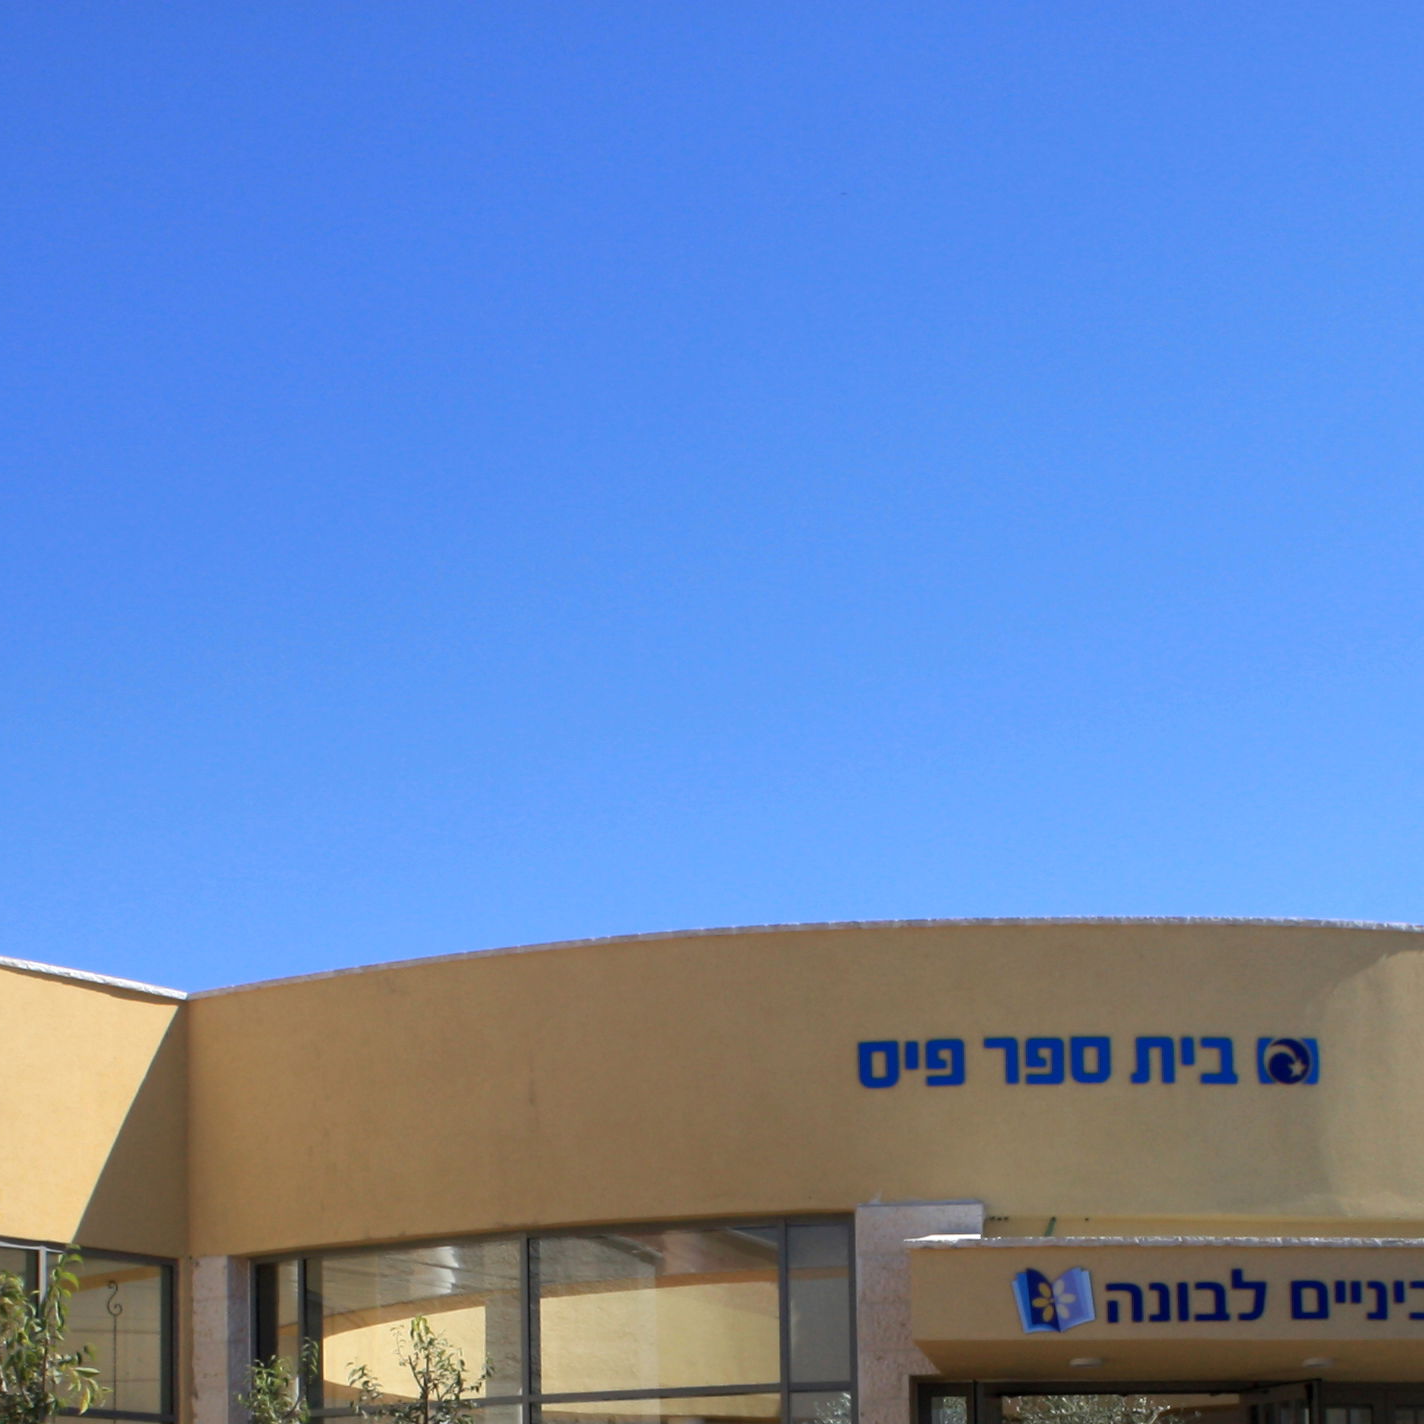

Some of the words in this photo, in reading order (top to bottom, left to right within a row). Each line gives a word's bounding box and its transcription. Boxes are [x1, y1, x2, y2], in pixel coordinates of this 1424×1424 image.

[857, 1038, 967, 1089] פיס
[983, 1035, 1113, 1086] ספר
[1129, 1035, 1240, 1086] בית
[1106, 1268, 1268, 1323] לבונה
